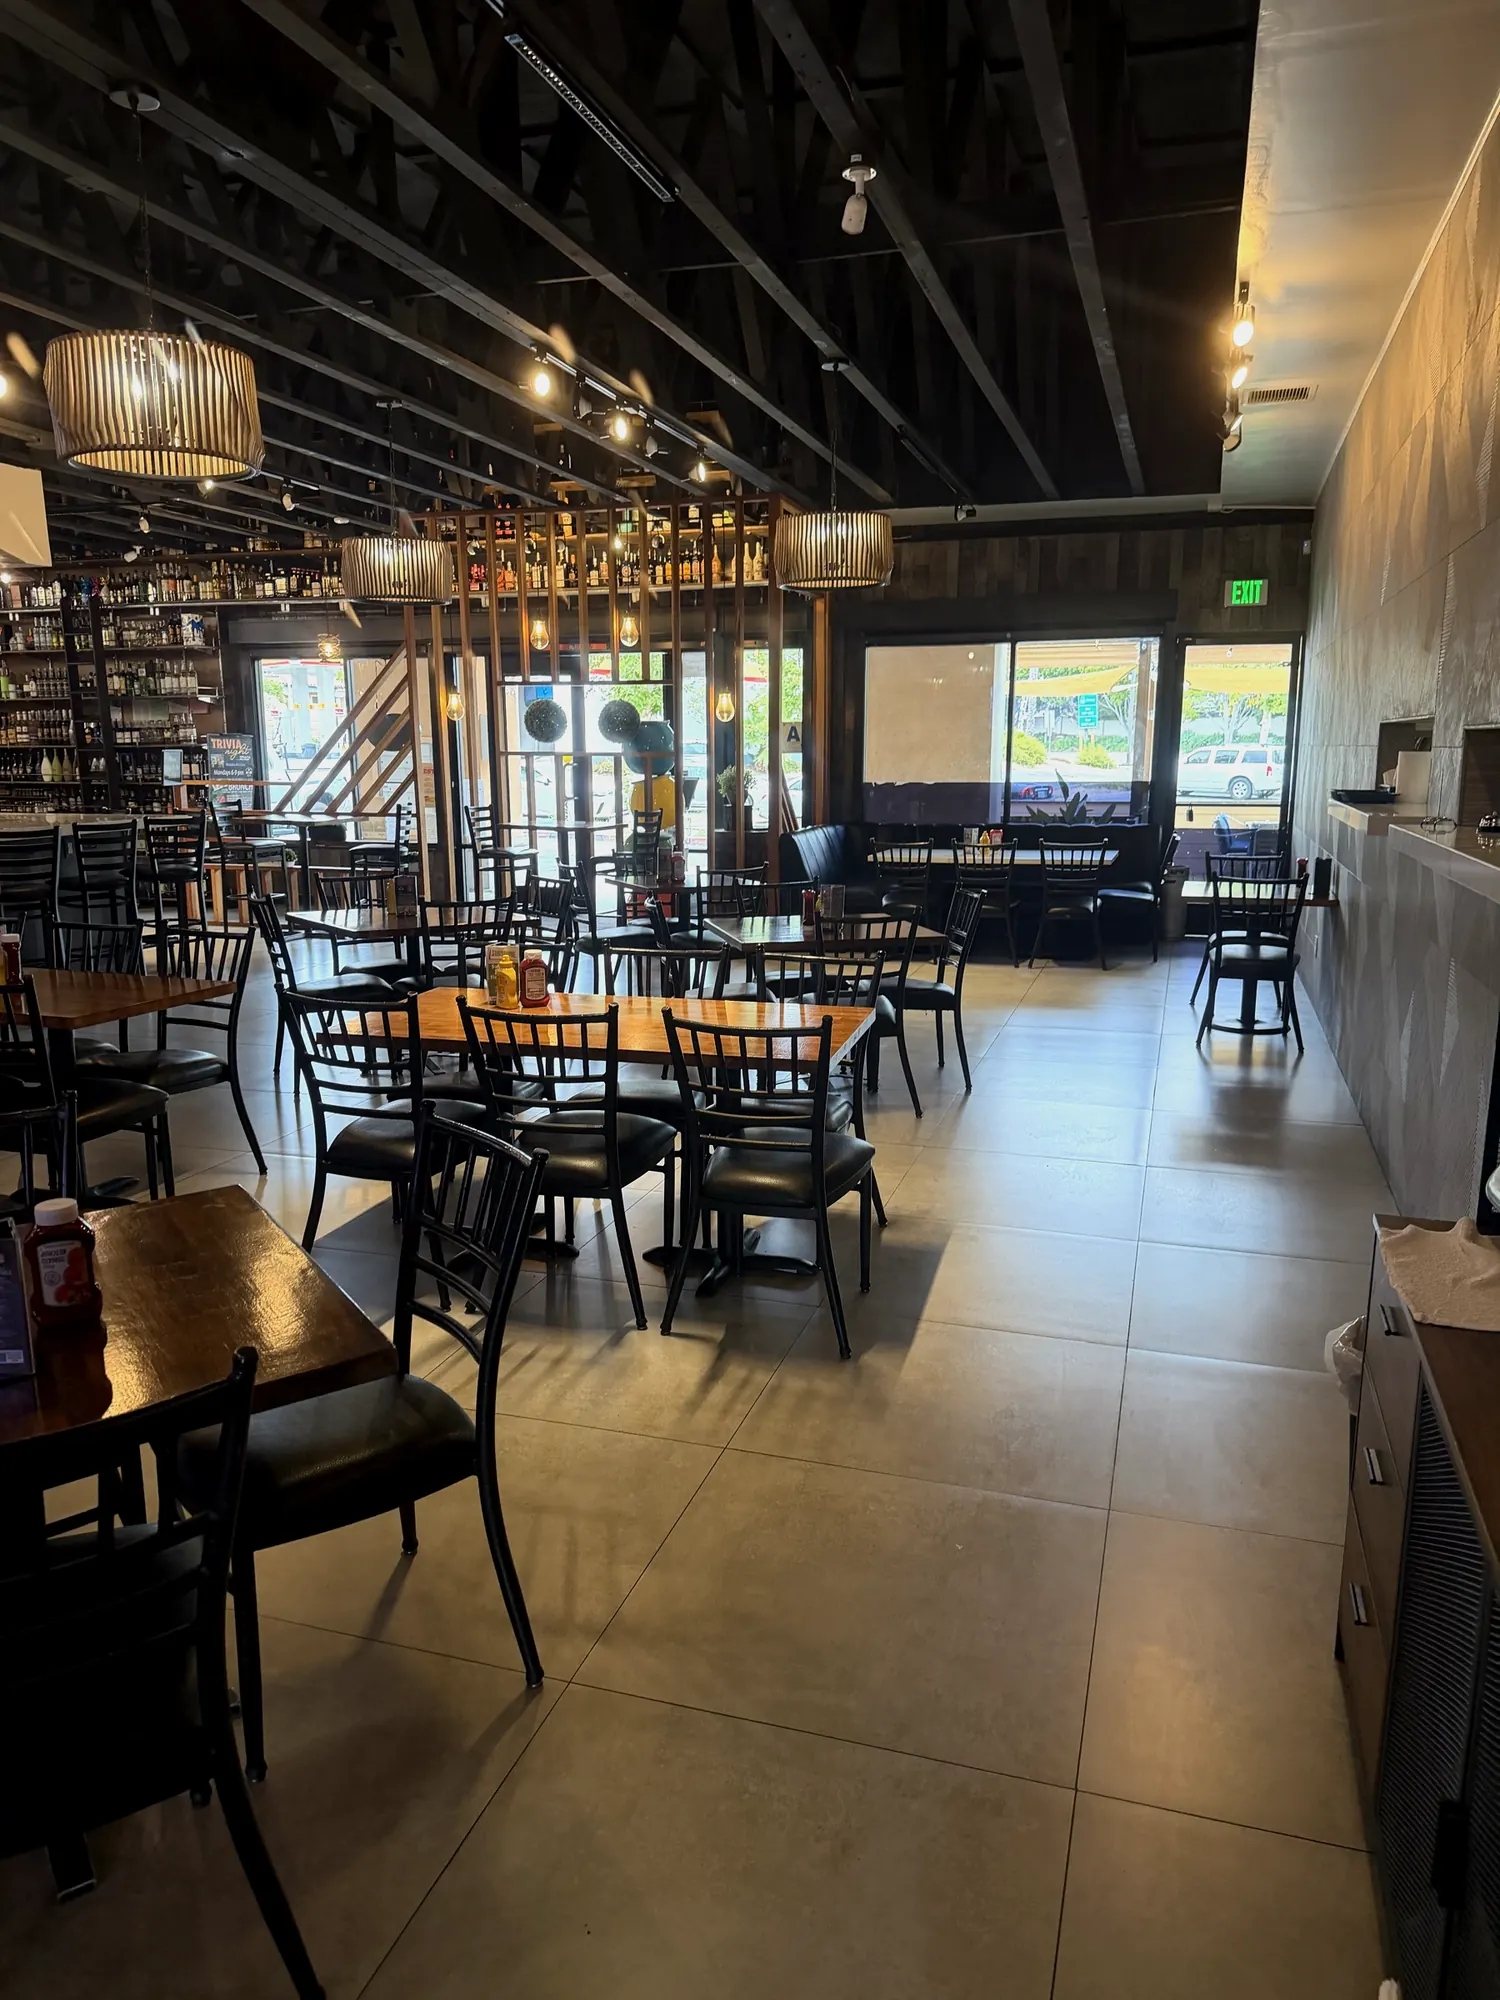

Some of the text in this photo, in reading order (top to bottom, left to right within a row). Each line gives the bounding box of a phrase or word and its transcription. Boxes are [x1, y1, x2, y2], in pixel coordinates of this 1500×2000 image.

[1231, 580, 1263, 605] EXIT
[786, 726, 801, 742] A
[211, 738, 241, 749] TRIVIA
[225, 743, 251, 760] night
